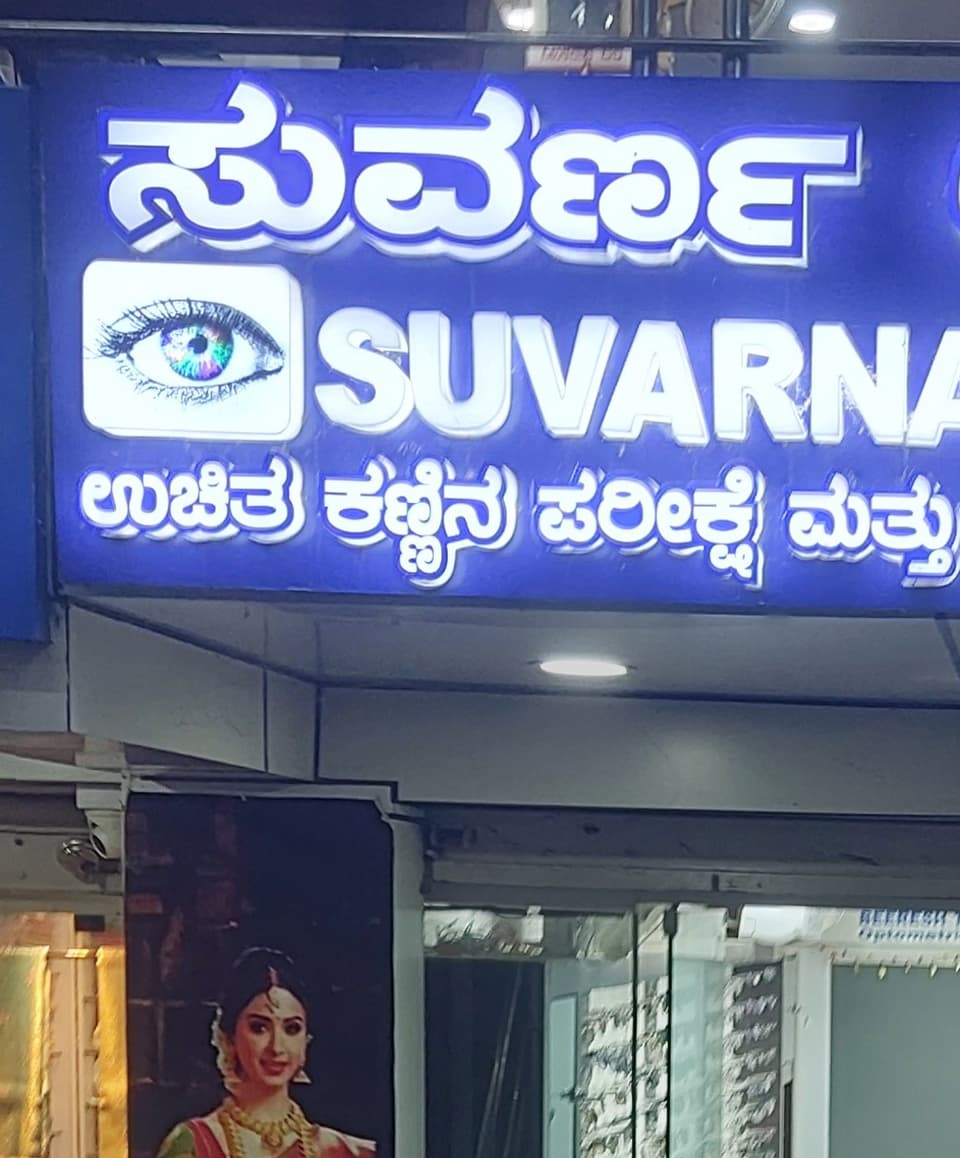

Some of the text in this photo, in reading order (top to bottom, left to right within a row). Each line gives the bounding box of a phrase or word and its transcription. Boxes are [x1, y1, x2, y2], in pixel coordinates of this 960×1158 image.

[104, 79, 856, 260] ಸುವರ್ಣ
[80, 461, 301, 546] ಉಚಿತ
[323, 458, 515, 585] ಕಣ್ಣಿನ
[537, 464, 762, 586] ಪರೀಕ್ಷೆ
